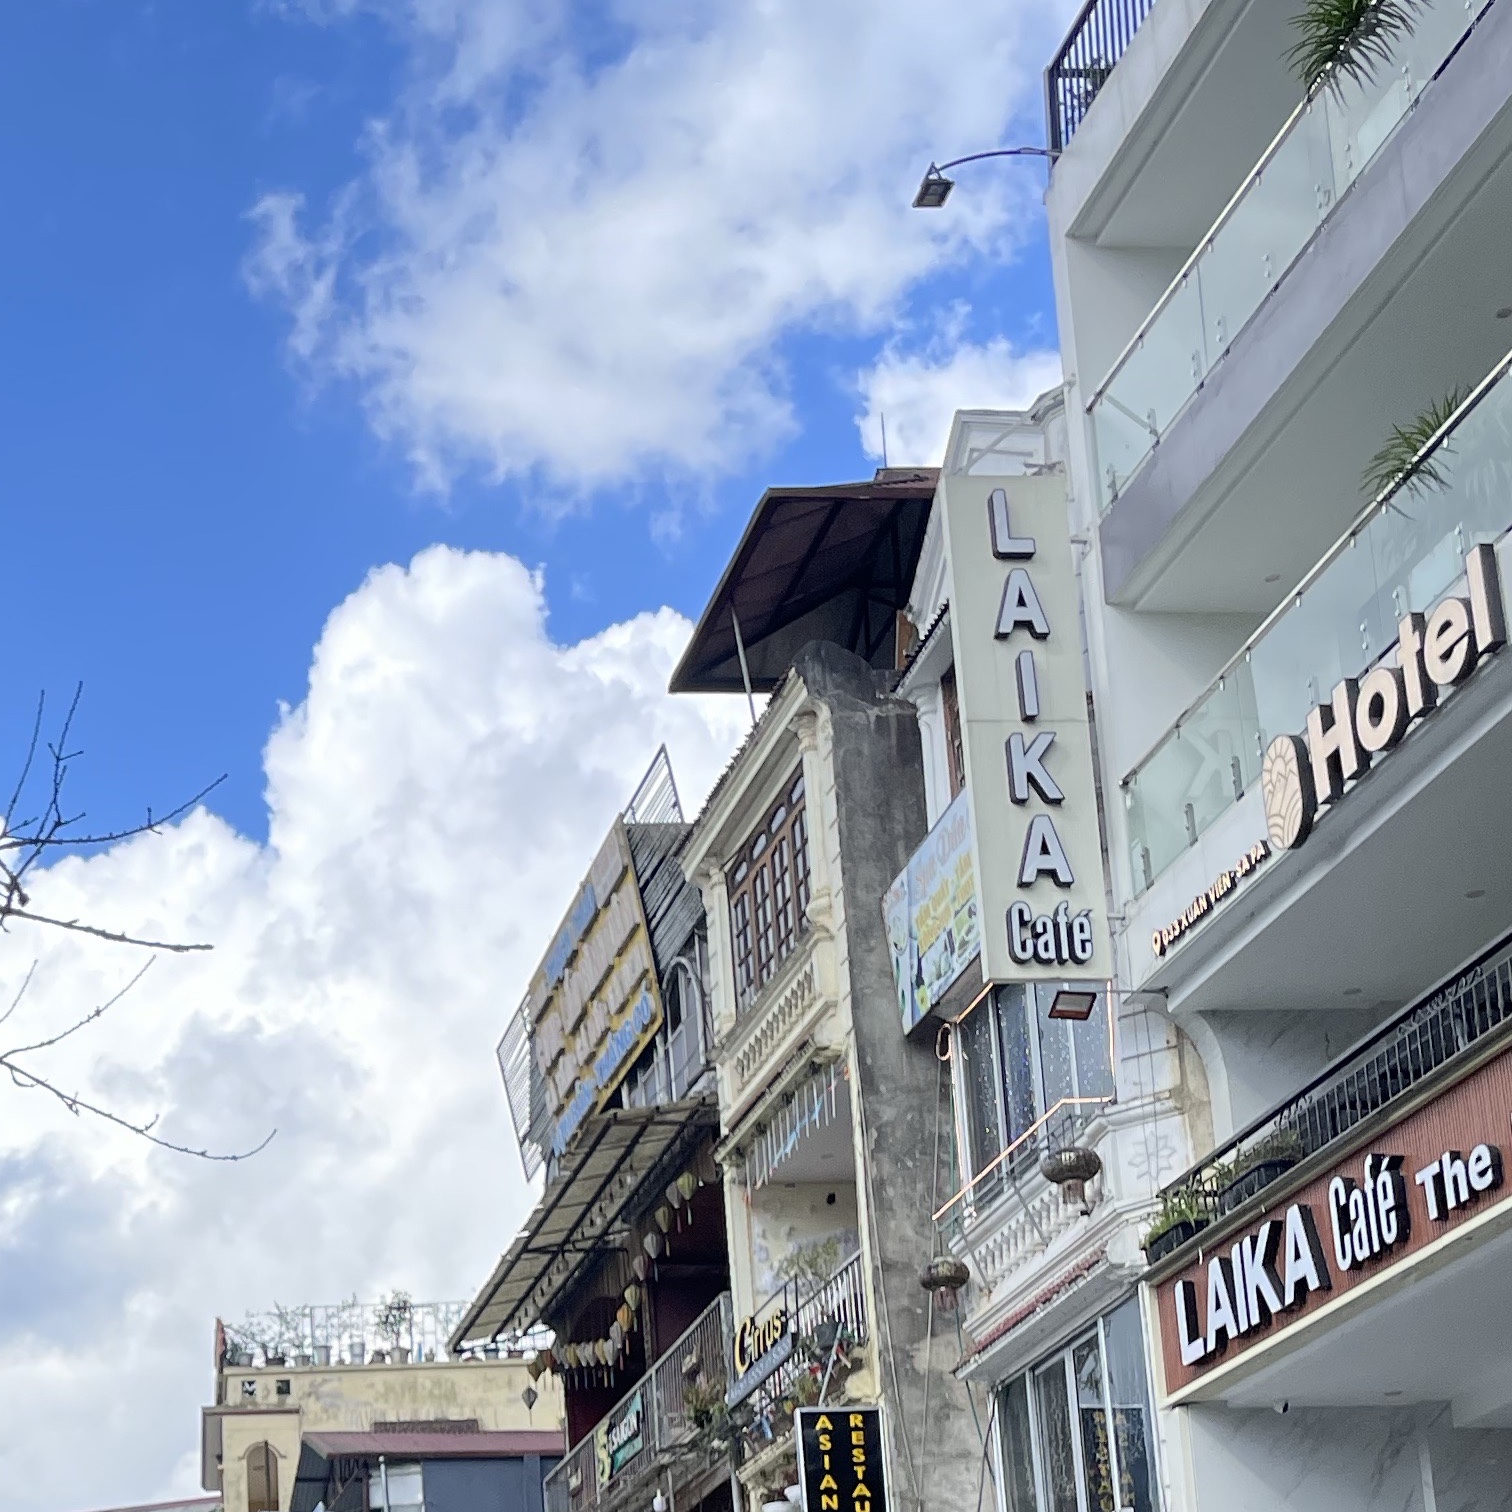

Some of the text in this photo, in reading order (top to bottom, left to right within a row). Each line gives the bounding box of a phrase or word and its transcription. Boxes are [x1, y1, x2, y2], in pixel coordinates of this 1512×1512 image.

[988, 488, 1075, 888] LAIKA
[1306, 543, 1505, 805] Hotel
[1007, 901, 1094, 965] Café
[1174, 1143, 1499, 1366] LAIKA Café The
[735, 1309, 786, 1374] Cirrus
[815, 1414, 838, 1511] ASIAN
